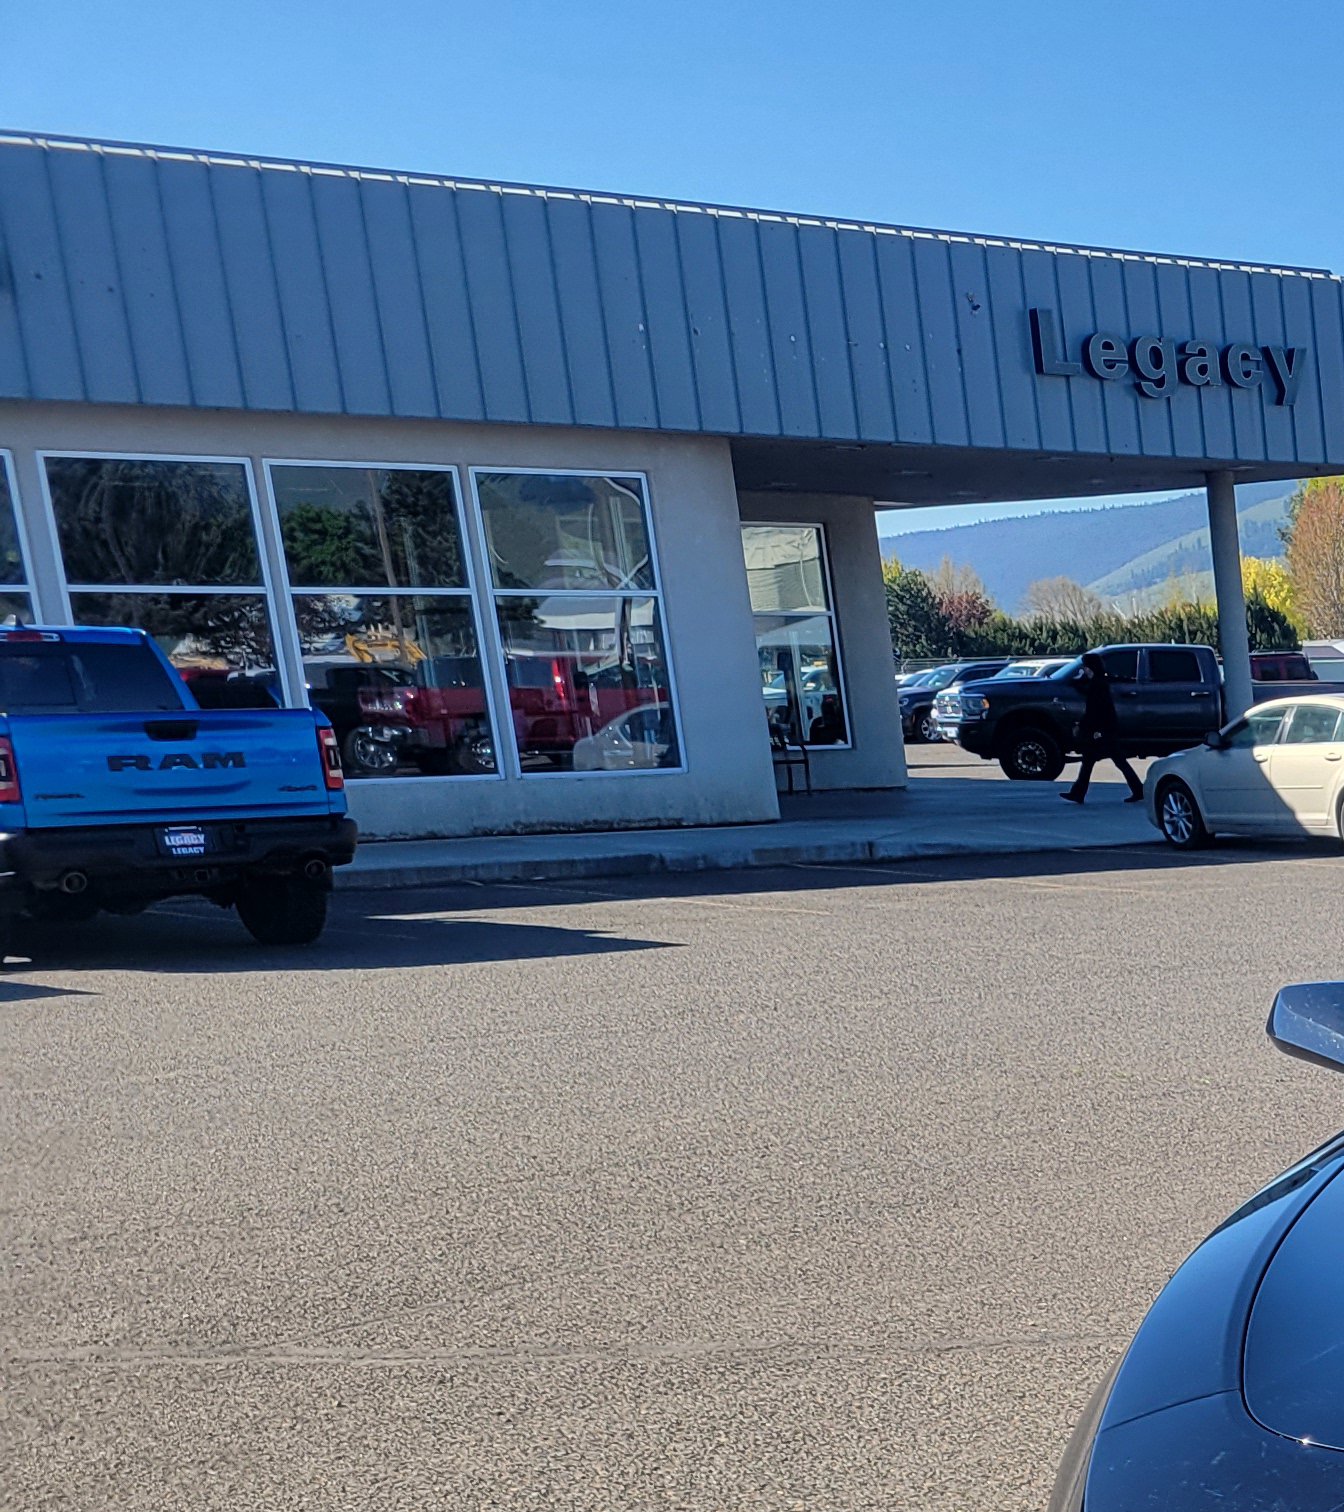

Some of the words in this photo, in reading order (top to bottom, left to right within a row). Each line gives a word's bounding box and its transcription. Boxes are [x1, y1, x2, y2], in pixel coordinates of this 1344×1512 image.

[1029, 307, 1307, 406] Legacy
[107, 752, 247, 772] RAM
[165, 835, 205, 846] LEGACY
